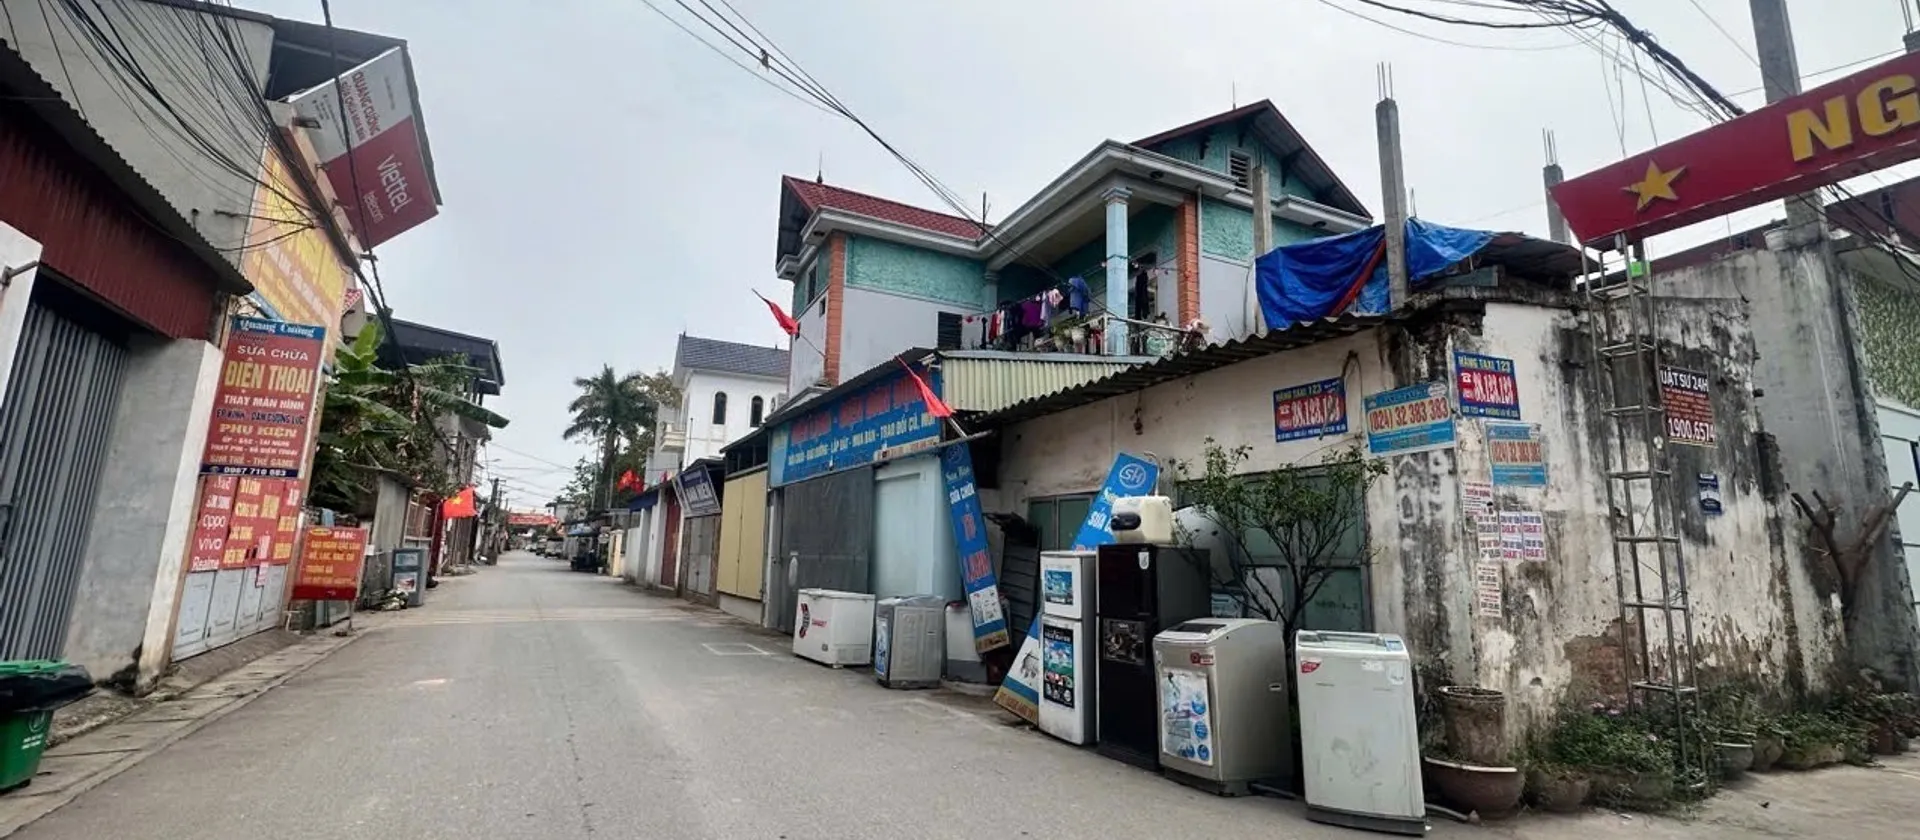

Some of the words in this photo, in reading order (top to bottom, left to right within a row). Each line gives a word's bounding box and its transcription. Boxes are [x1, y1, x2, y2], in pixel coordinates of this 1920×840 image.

[352, 71, 371, 108] QUANG
[377, 152, 412, 213] viettel
[240, 319, 276, 334] Quang
[238, 342, 266, 356] SỬA
[271, 347, 309, 361] CHỮA
[1496, 359, 1511, 372] 123
[224, 357, 265, 394] ĐIỆN
[268, 365, 315, 399] THOẠI
[1659, 366, 1679, 388] UẬT
[1692, 375, 1710, 392] 24H
[1308, 383, 1321, 395] 123
[224, 395, 250, 406] THAY
[1369, 408, 1393, 432] (024)
[1395, 405, 1408, 426] 32
[1408, 401, 1428, 424] 383
[1428, 397, 1449, 421] 383
[1668, 418, 1717, 442] 1900.6574
[1121, 467, 1143, 483] SH
